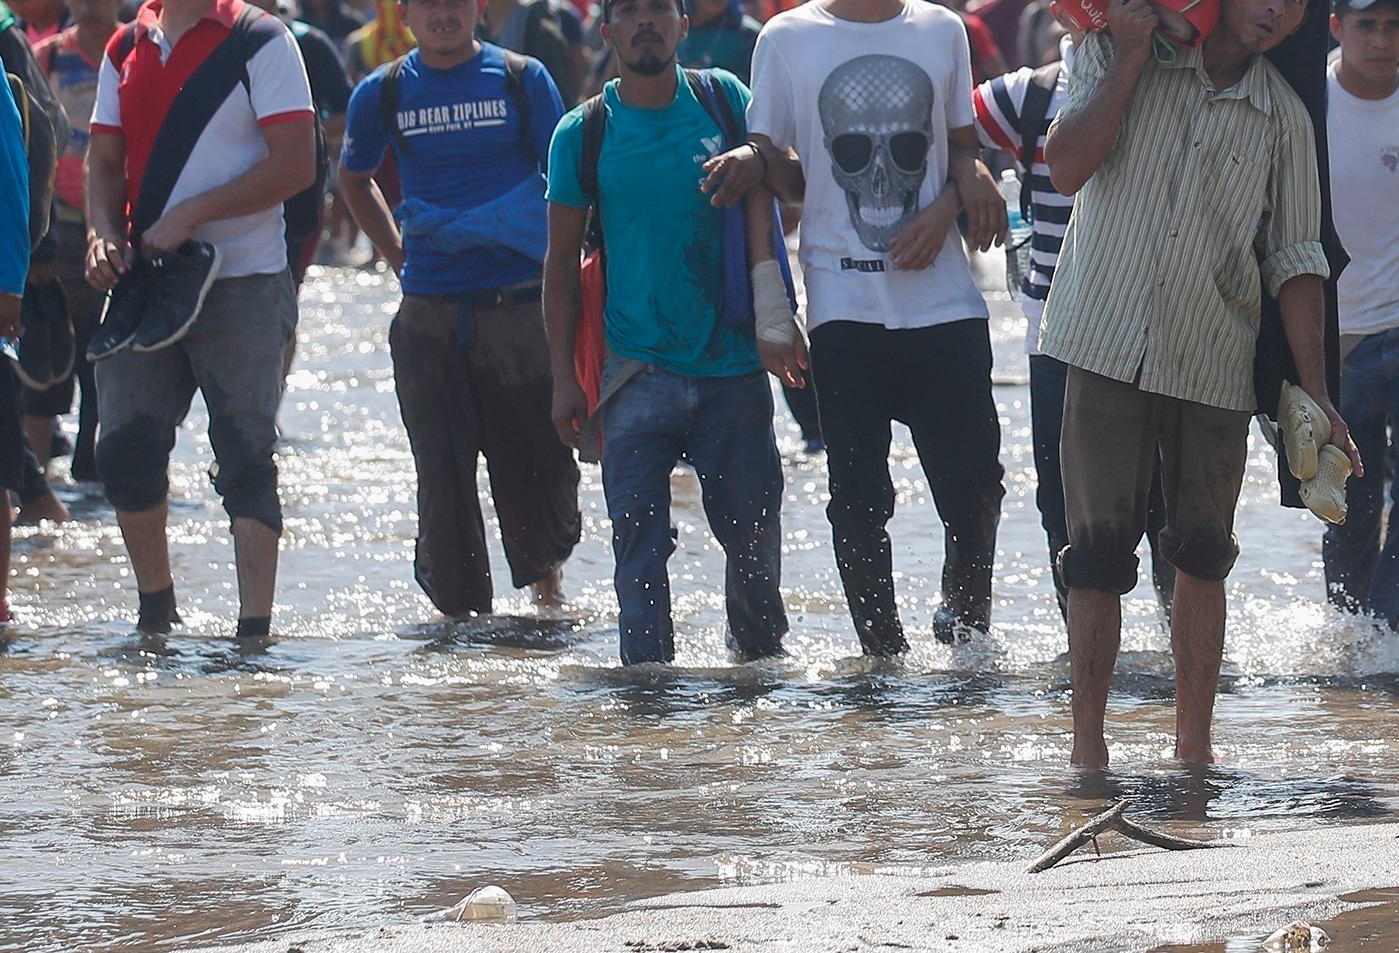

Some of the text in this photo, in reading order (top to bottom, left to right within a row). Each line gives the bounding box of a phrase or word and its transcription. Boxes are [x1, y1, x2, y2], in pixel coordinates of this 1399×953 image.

[396, 99, 508, 130] BIG BEAR ZIPLINES
